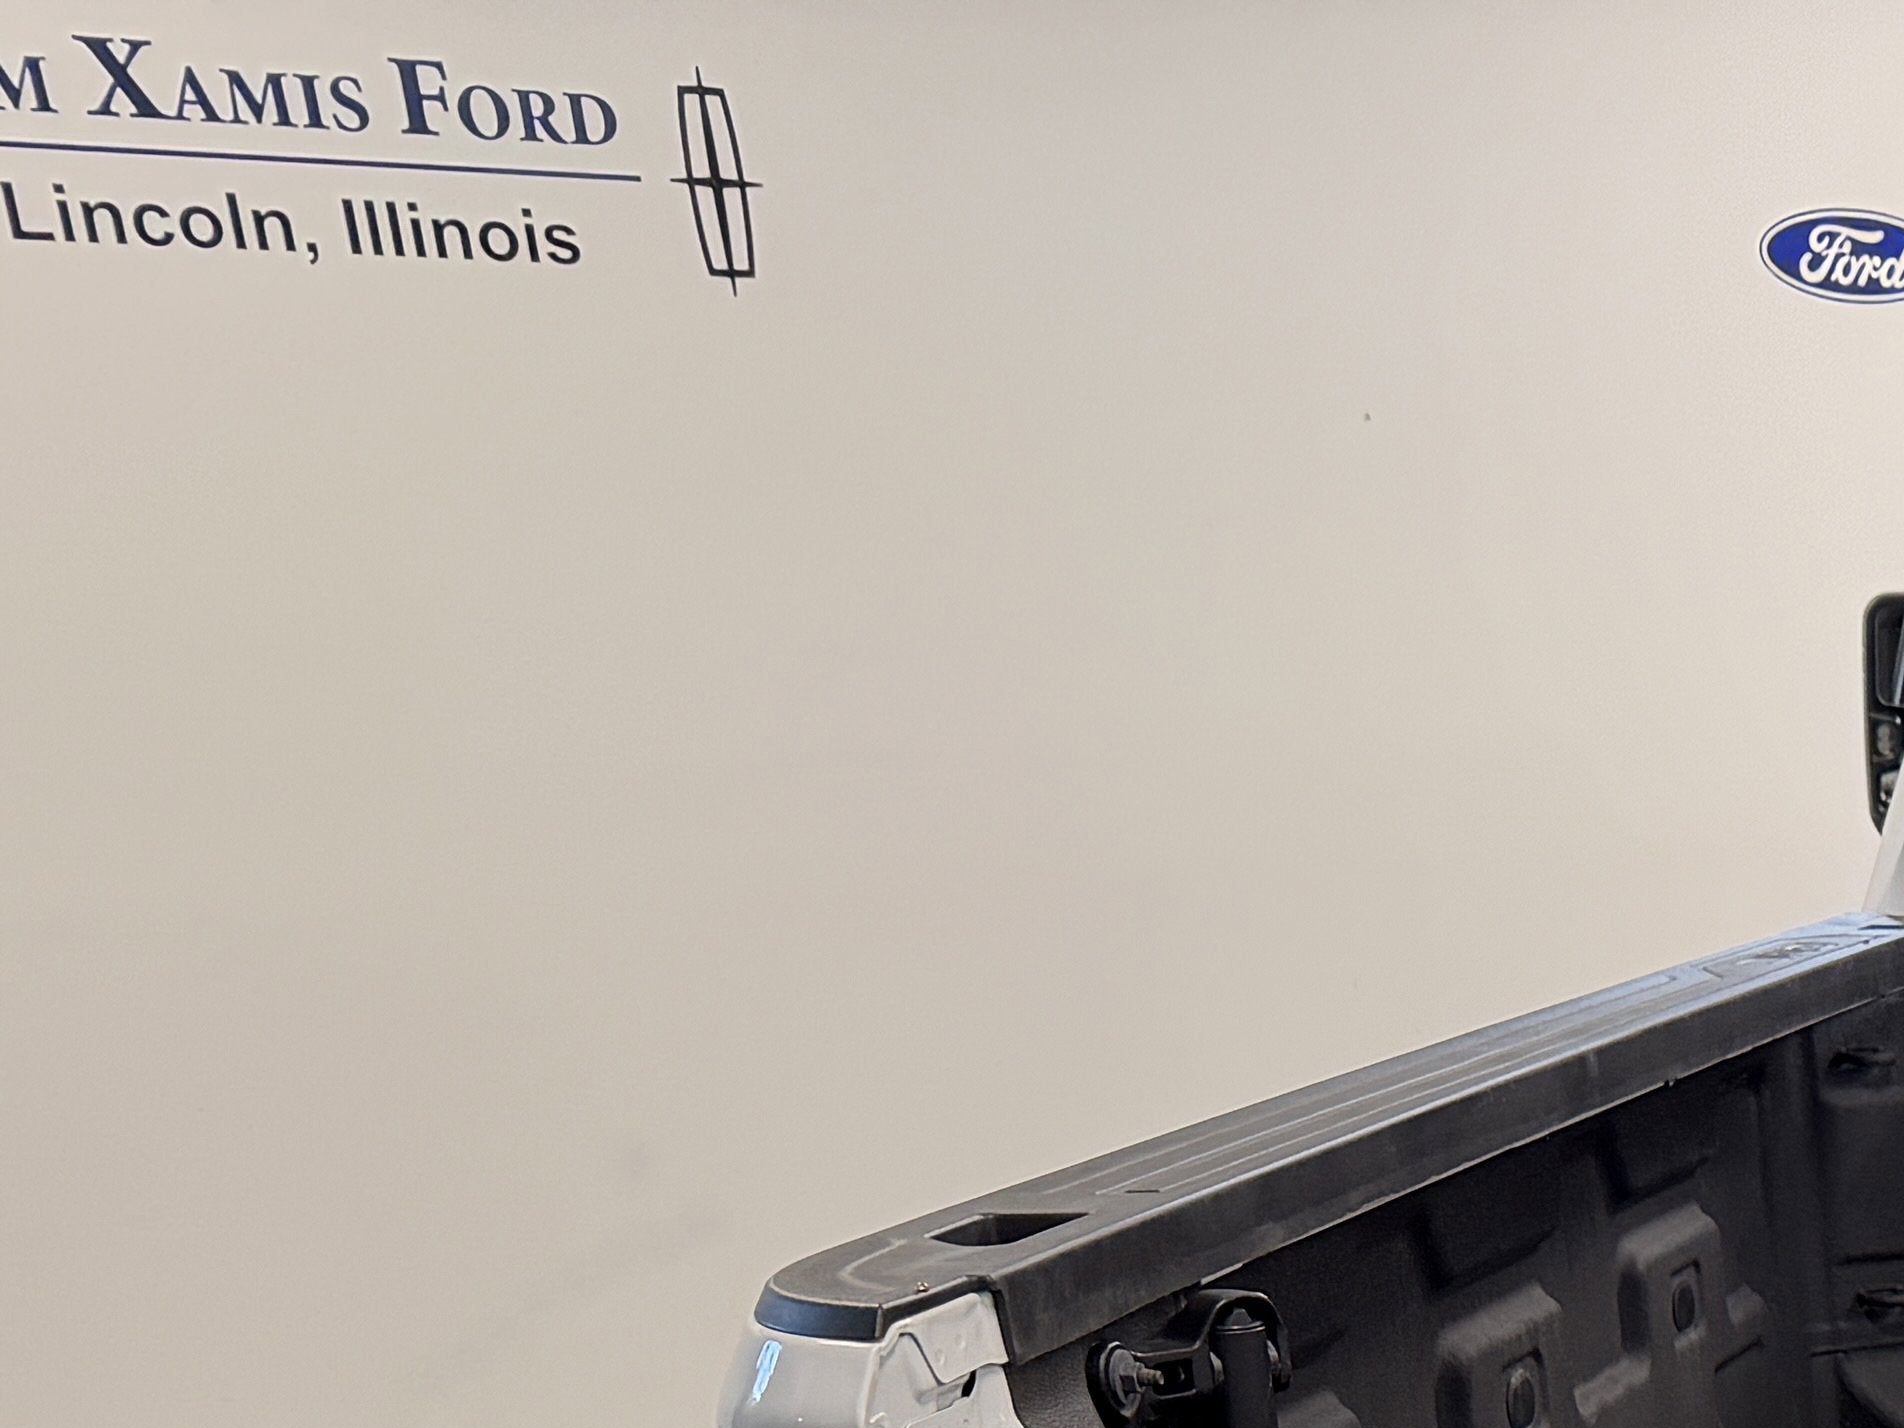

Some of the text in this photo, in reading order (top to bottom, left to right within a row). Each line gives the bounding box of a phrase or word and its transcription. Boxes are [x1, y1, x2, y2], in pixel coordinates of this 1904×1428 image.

[71, 34, 370, 133] XAMIS
[387, 57, 618, 146] FORD
[0, 181, 582, 265] Lincoln, Illinois
